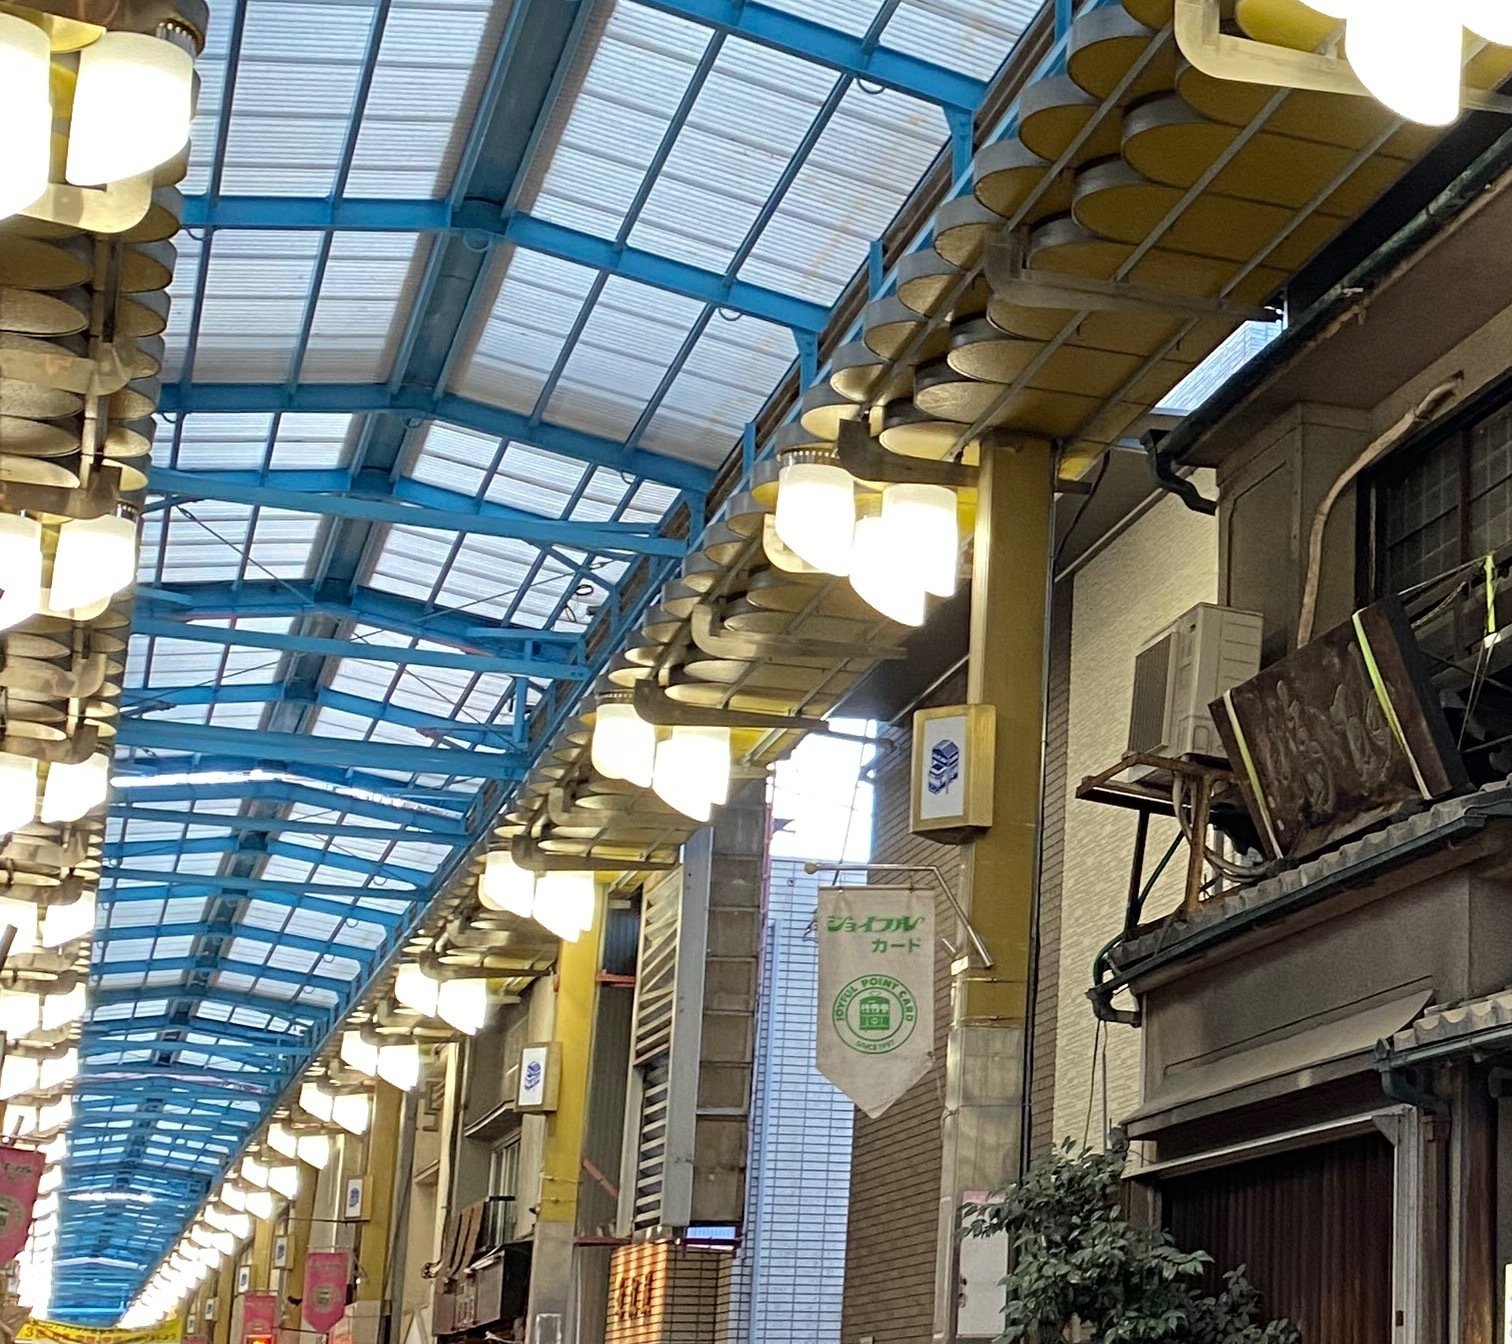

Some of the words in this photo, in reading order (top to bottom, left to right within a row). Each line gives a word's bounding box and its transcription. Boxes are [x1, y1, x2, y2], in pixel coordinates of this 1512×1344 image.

[827, 914, 926, 934] ジョイフル
[871, 937, 922, 954] カード
[836, 986, 859, 1022] JOYFUL
[898, 990, 914, 1022] CARD
